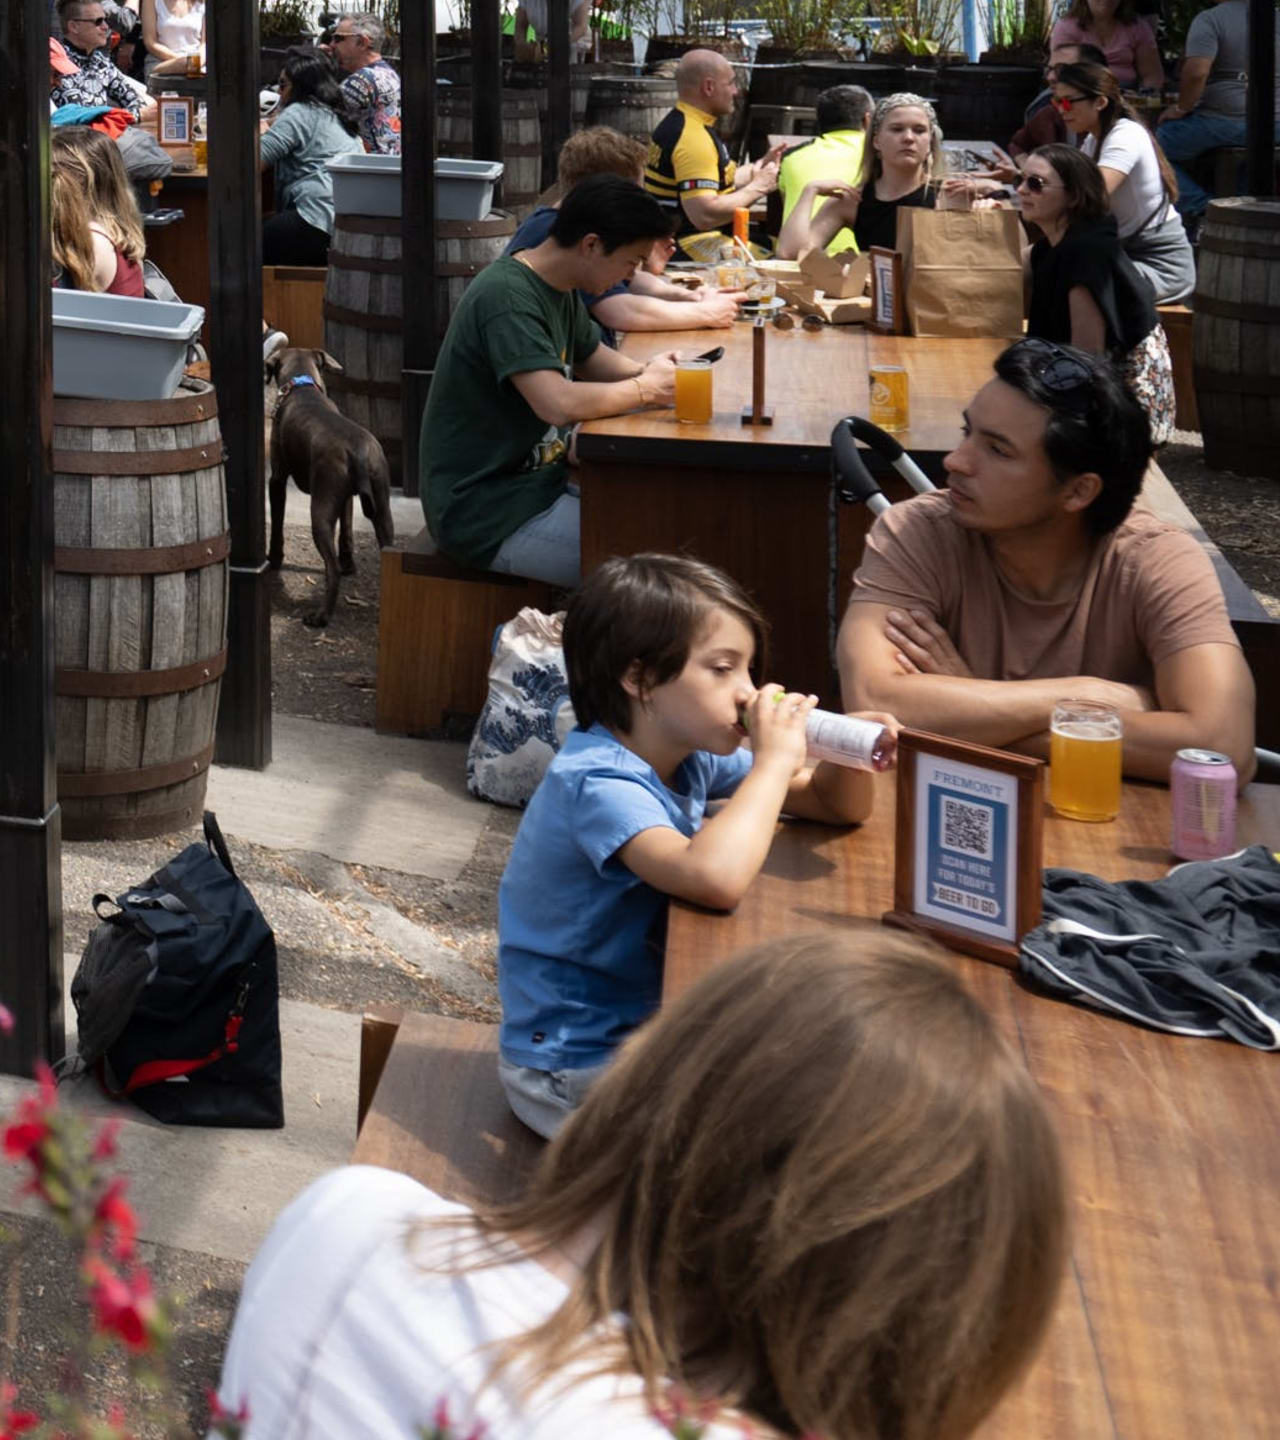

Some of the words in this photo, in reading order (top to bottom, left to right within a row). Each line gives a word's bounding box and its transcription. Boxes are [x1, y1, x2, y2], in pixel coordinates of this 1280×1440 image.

[934, 769, 1004, 798] FREMONT
[938, 867, 956, 883] FOR
[958, 872, 996, 894] TODAY'S
[968, 861, 992, 878] HERE
[939, 886, 964, 906] BEER
[965, 894, 979, 910] TO
[981, 900, 996, 914] GO
